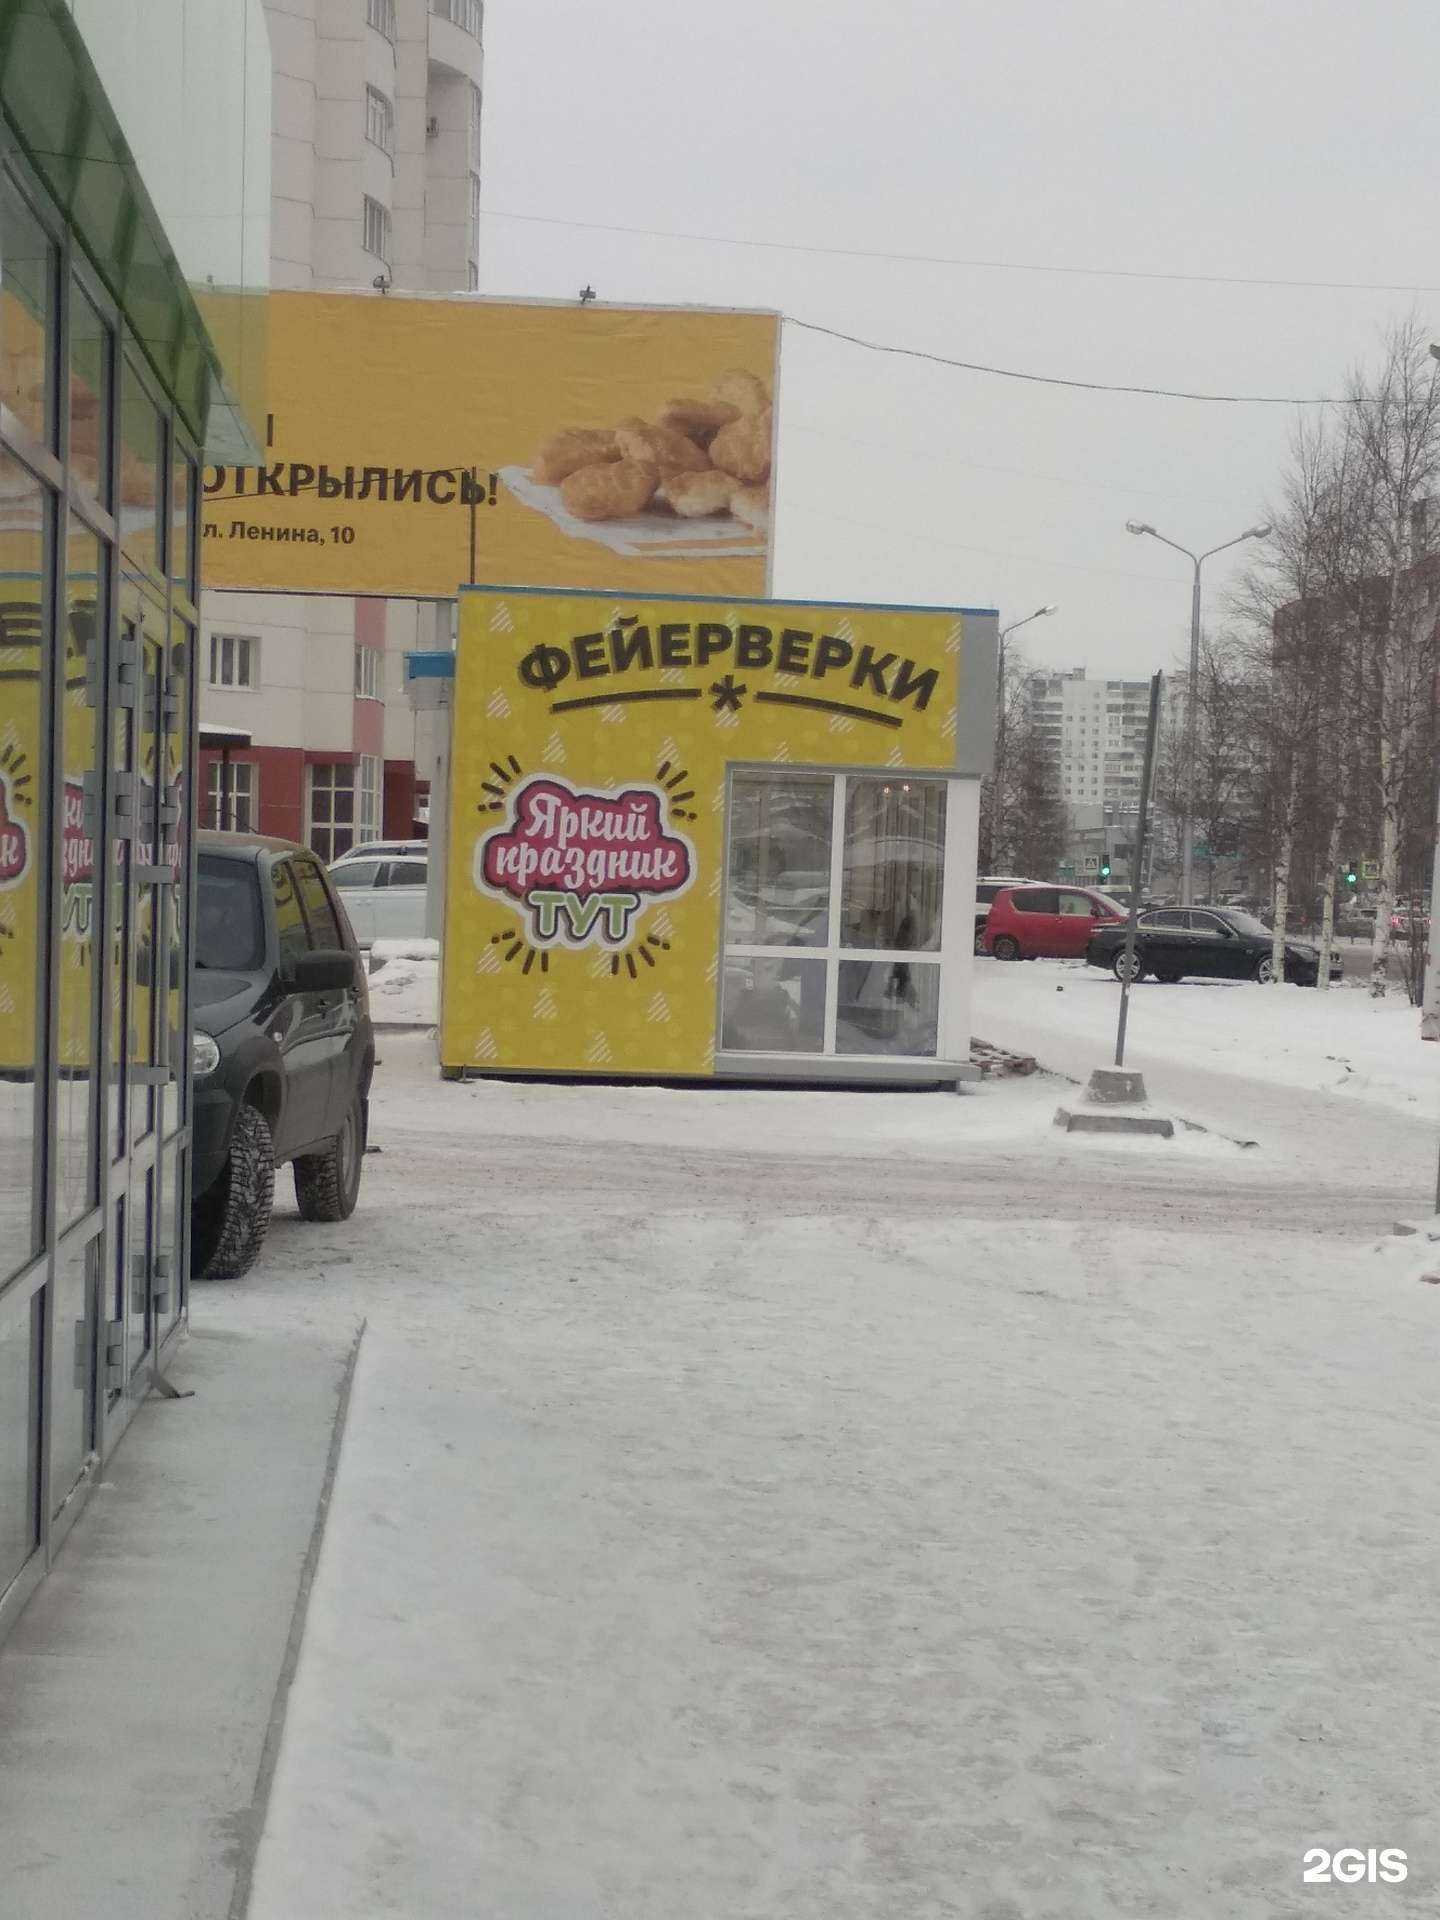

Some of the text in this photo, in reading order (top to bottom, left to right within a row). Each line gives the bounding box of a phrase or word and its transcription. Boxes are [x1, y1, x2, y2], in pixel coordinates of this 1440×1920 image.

[203, 521, 356, 546] л. Ленина, 10
[519, 615, 940, 712] ФЕЙЕРВЕРКИ
[524, 792, 651, 849] Яркий
[496, 842, 679, 889] праздник
[528, 891, 638, 938] ТУТ
